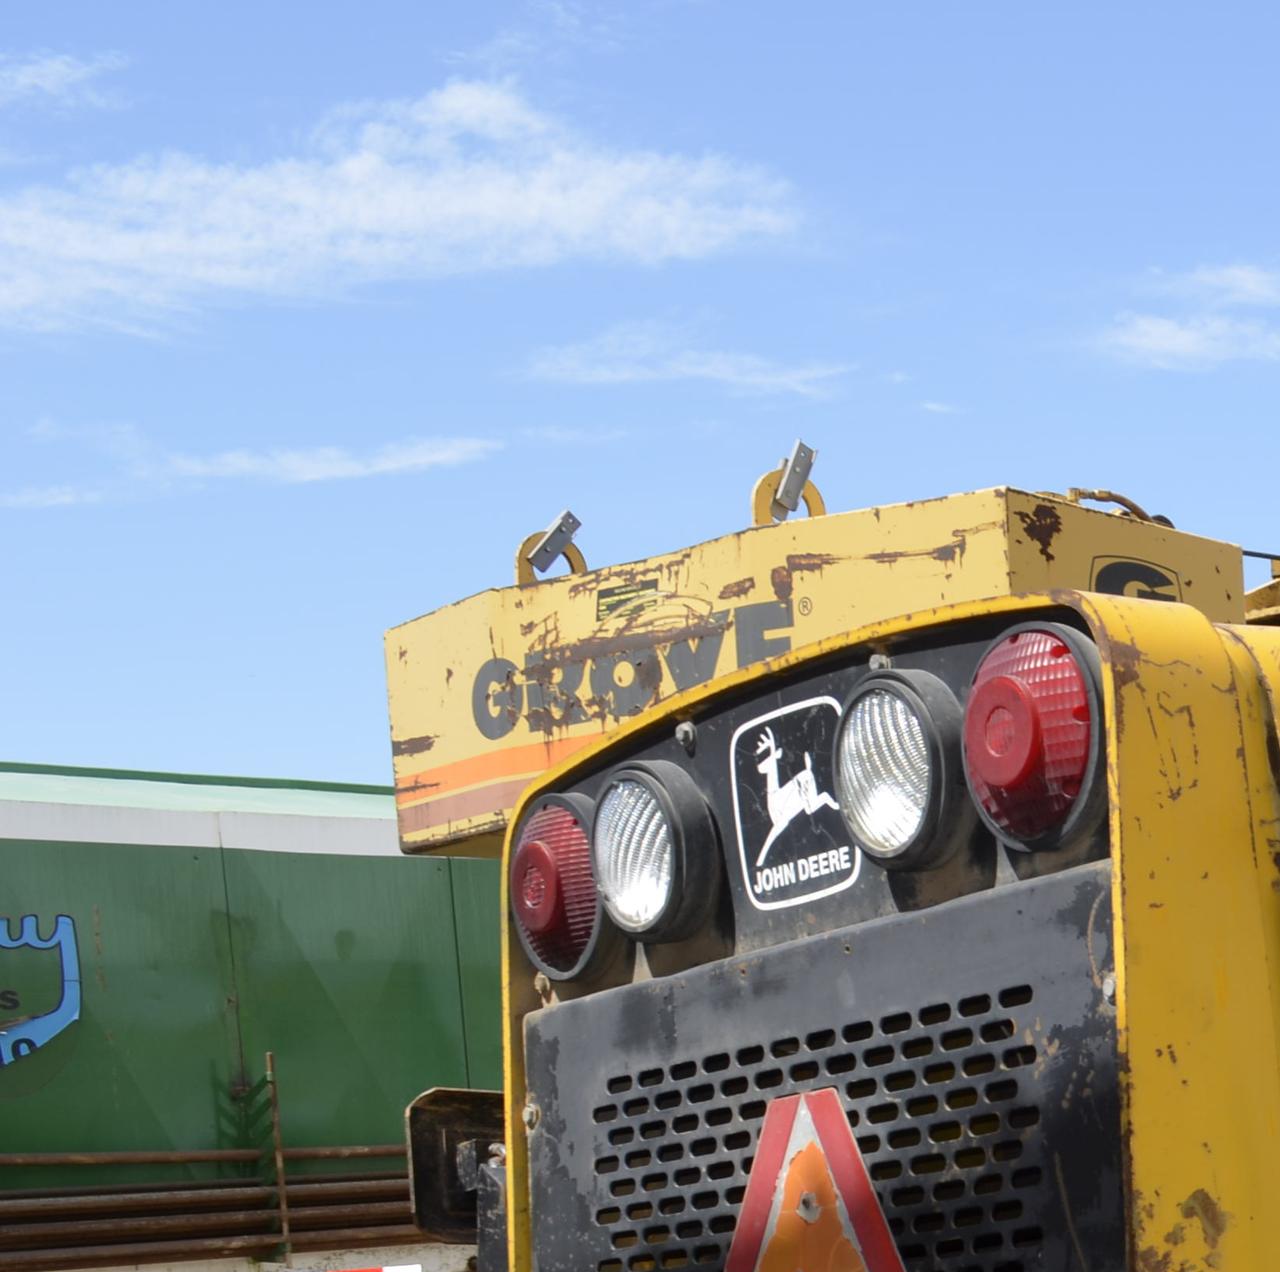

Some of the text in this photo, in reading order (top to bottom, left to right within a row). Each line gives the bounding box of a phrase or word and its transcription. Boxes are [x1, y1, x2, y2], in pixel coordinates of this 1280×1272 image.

[471, 599, 796, 740] GROVE
[753, 846, 852, 894] JOHN DEERE
